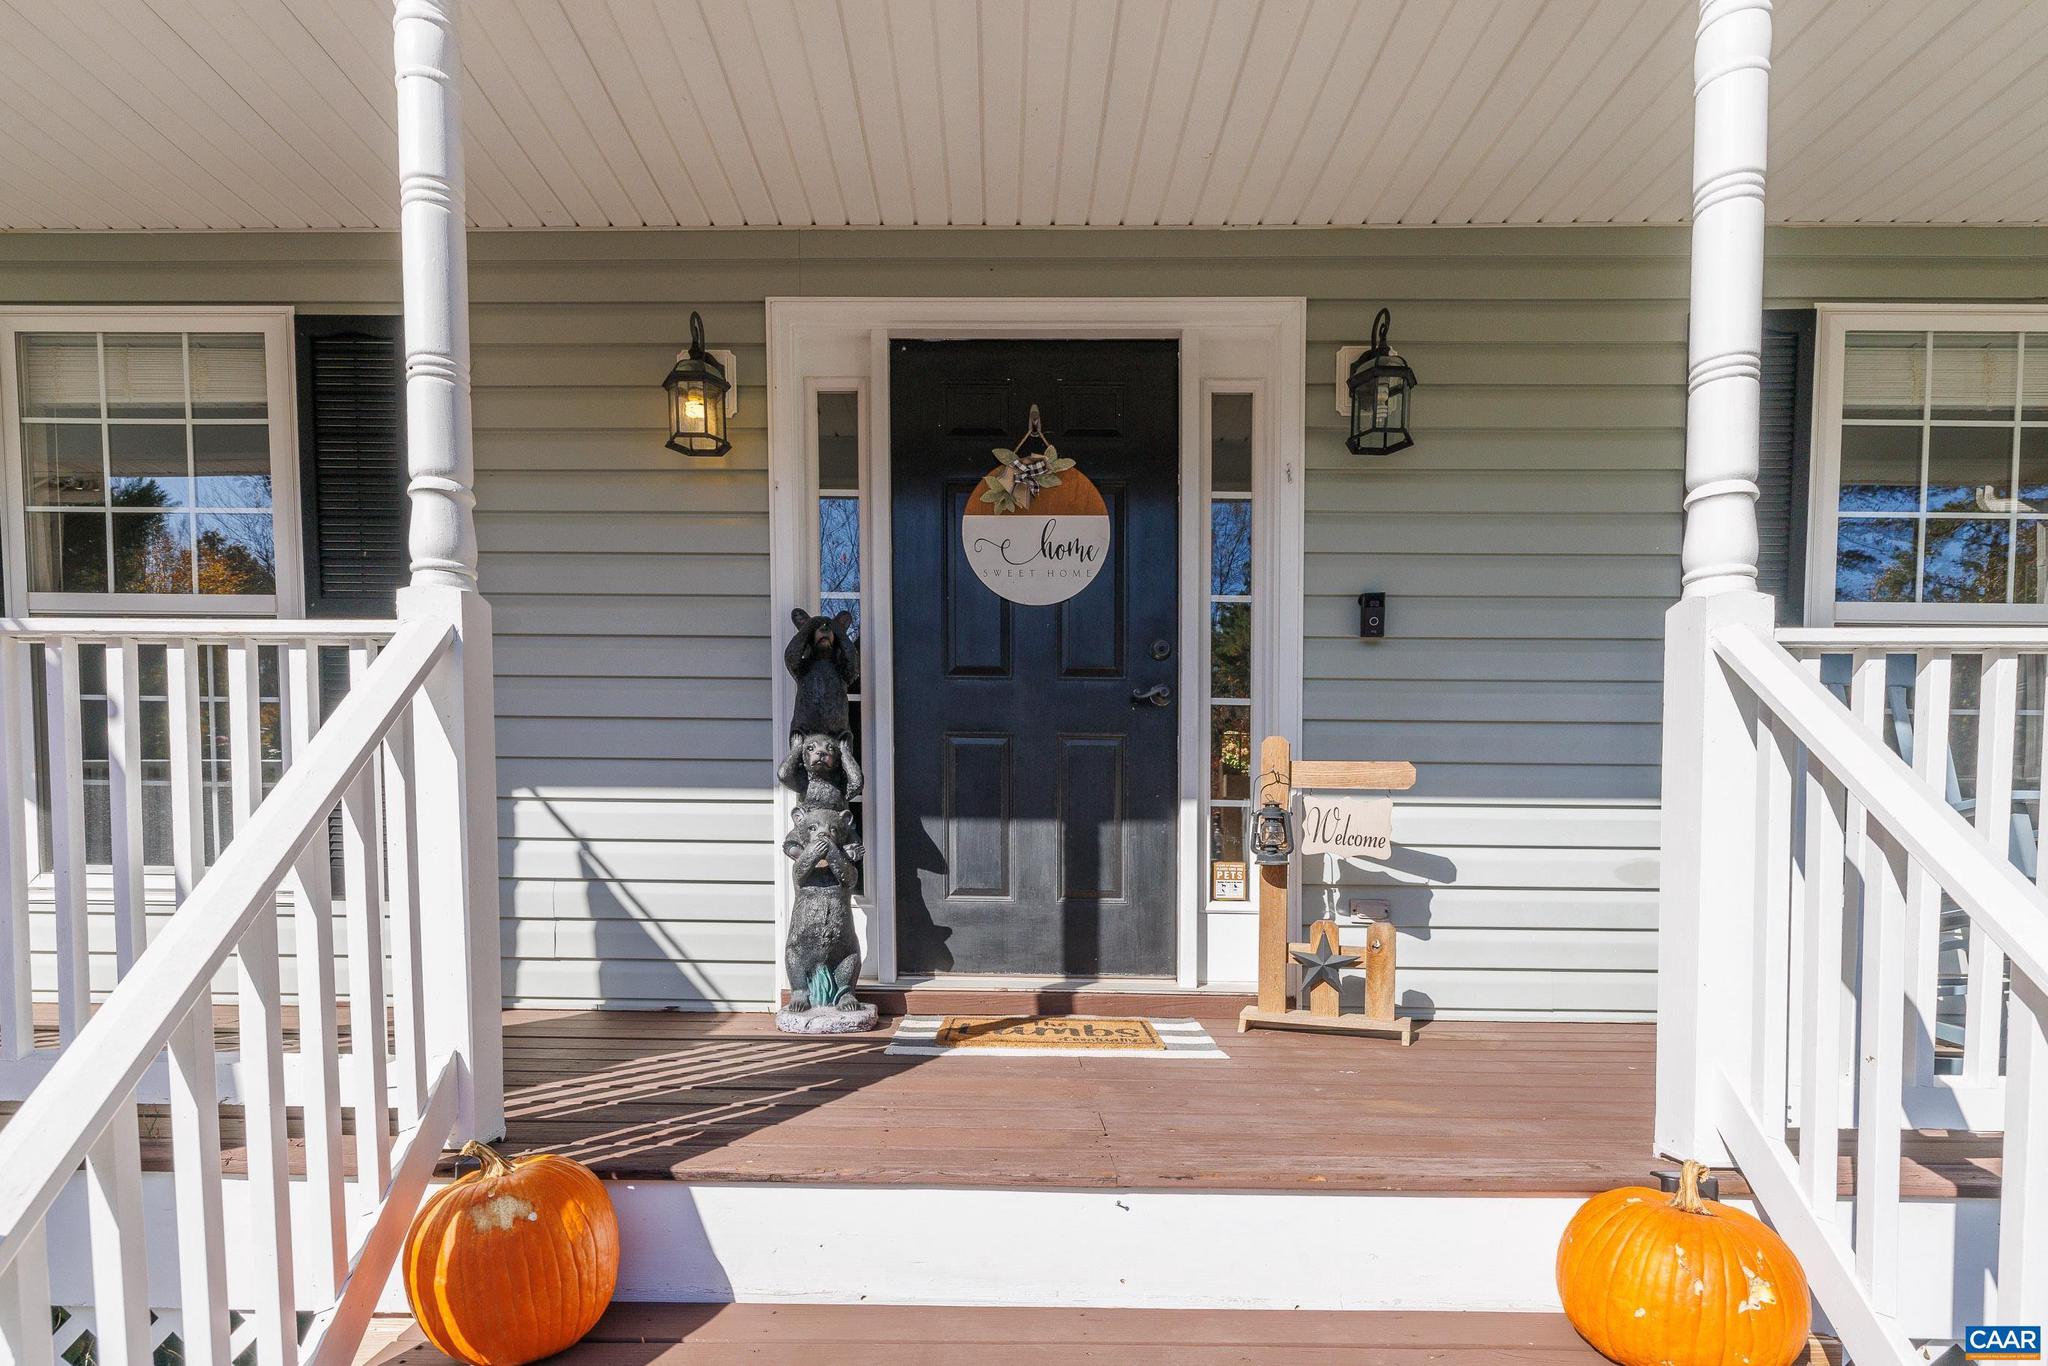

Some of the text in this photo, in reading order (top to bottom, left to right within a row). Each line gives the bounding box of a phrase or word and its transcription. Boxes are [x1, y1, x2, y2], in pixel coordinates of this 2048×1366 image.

[982, 569, 1093, 578] SWEET HOME
[1306, 806, 1386, 849] Welcome
[1216, 871, 1243, 880] PETS
